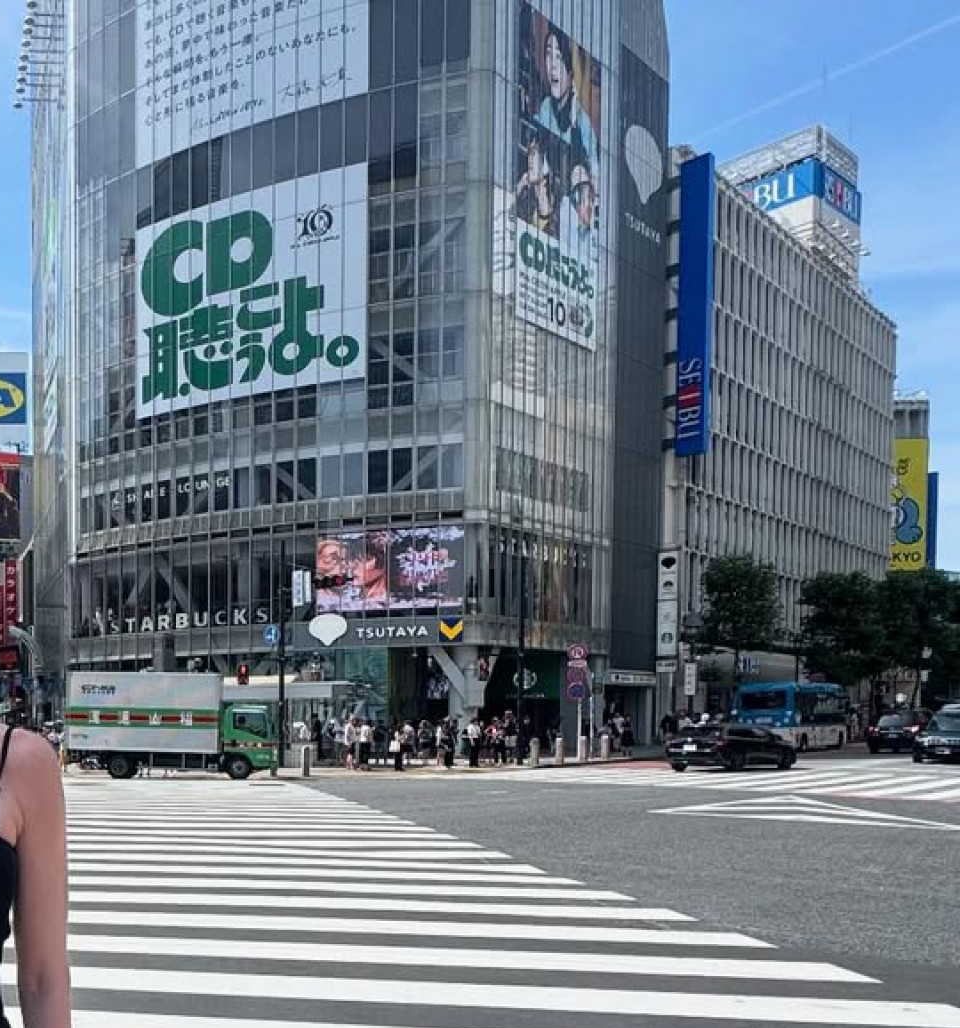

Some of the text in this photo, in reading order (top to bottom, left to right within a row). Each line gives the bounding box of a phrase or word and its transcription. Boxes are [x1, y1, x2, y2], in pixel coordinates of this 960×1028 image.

[141, 209, 273, 317] CD
[677, 357, 703, 440] SEIBU
[889, 552, 923, 563] KYO
[110, 608, 269, 635] STARBUCKS
[355, 625, 429, 639] TSUTAYA
